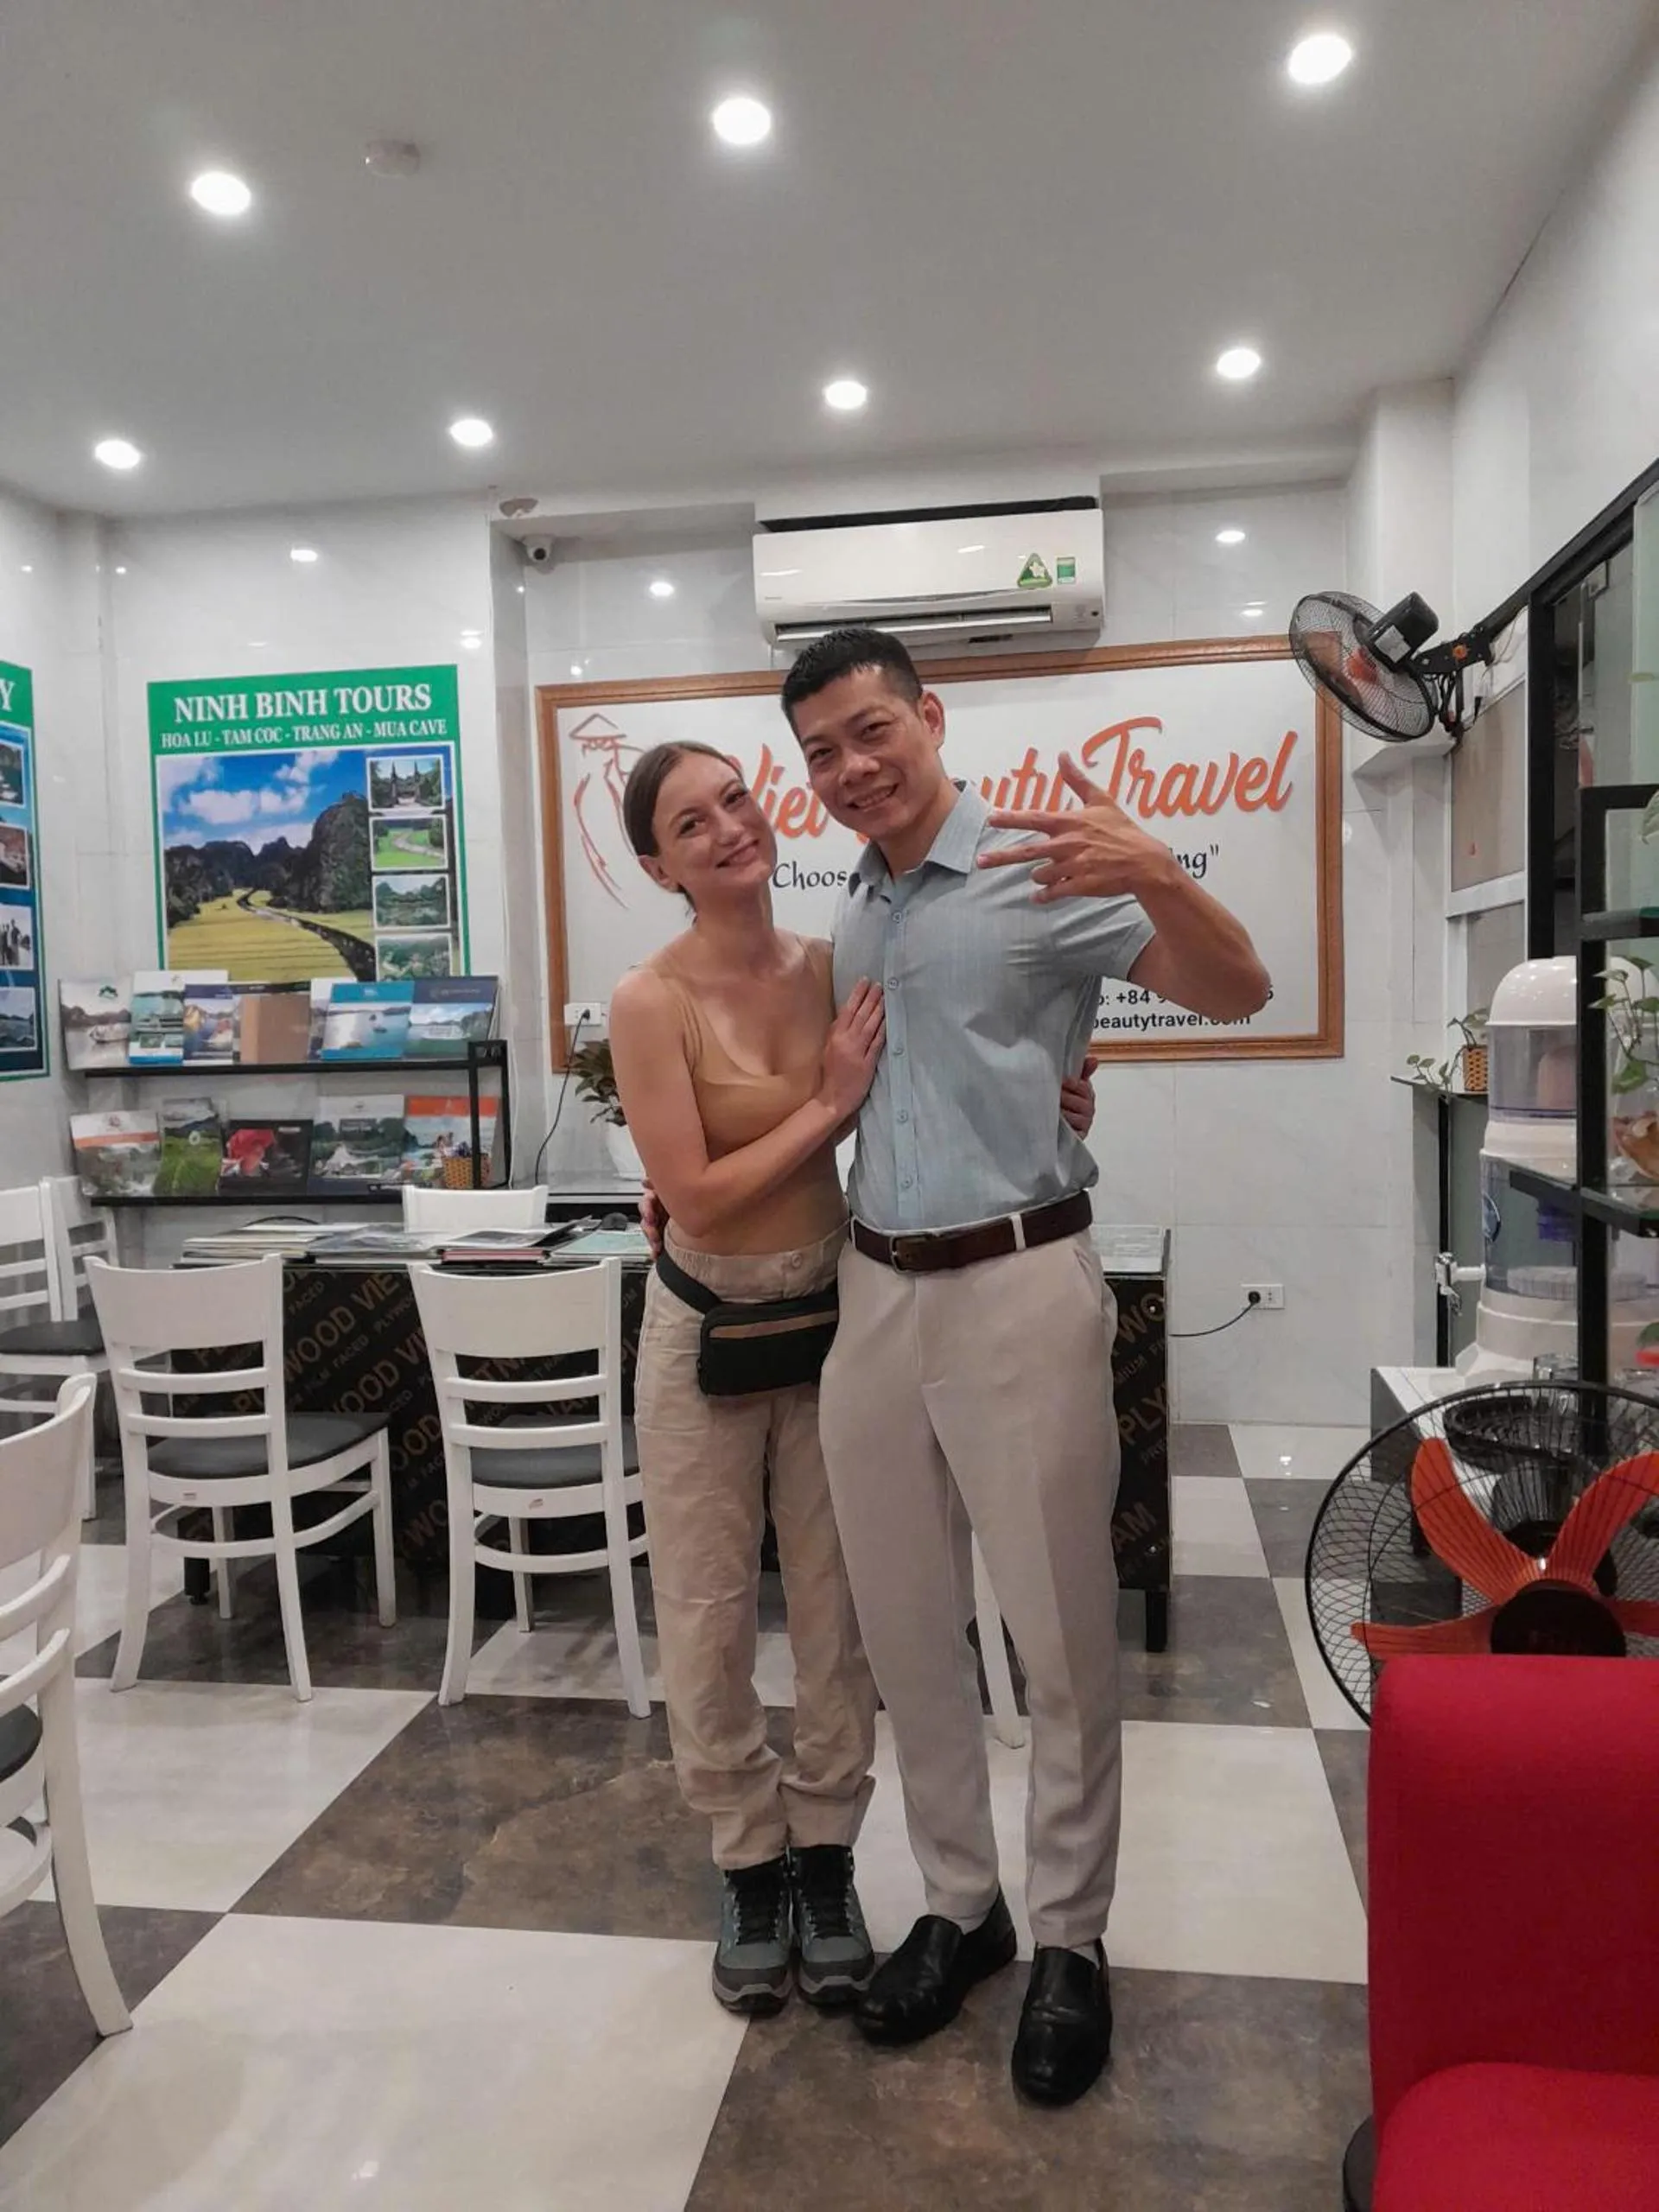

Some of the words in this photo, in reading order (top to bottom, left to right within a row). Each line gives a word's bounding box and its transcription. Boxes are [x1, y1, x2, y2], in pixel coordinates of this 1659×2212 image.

[175, 692, 248, 724] NINH
[256, 689, 327, 718] BINH
[334, 683, 432, 713] TOURS
[162, 732, 191, 748] HOA
[194, 730, 212, 747] LU
[222, 728, 252, 746] TAM
[255, 726, 283, 743] COC
[292, 723, 340, 741] TRANG
[343, 722, 363, 739] AN
[373, 721, 406, 738] MUA
[410, 719, 448, 736] CAVE
[1082, 715, 1298, 818] Travel
[772, 861, 849, 891] Choos
[1116, 988, 1150, 1005] +84
